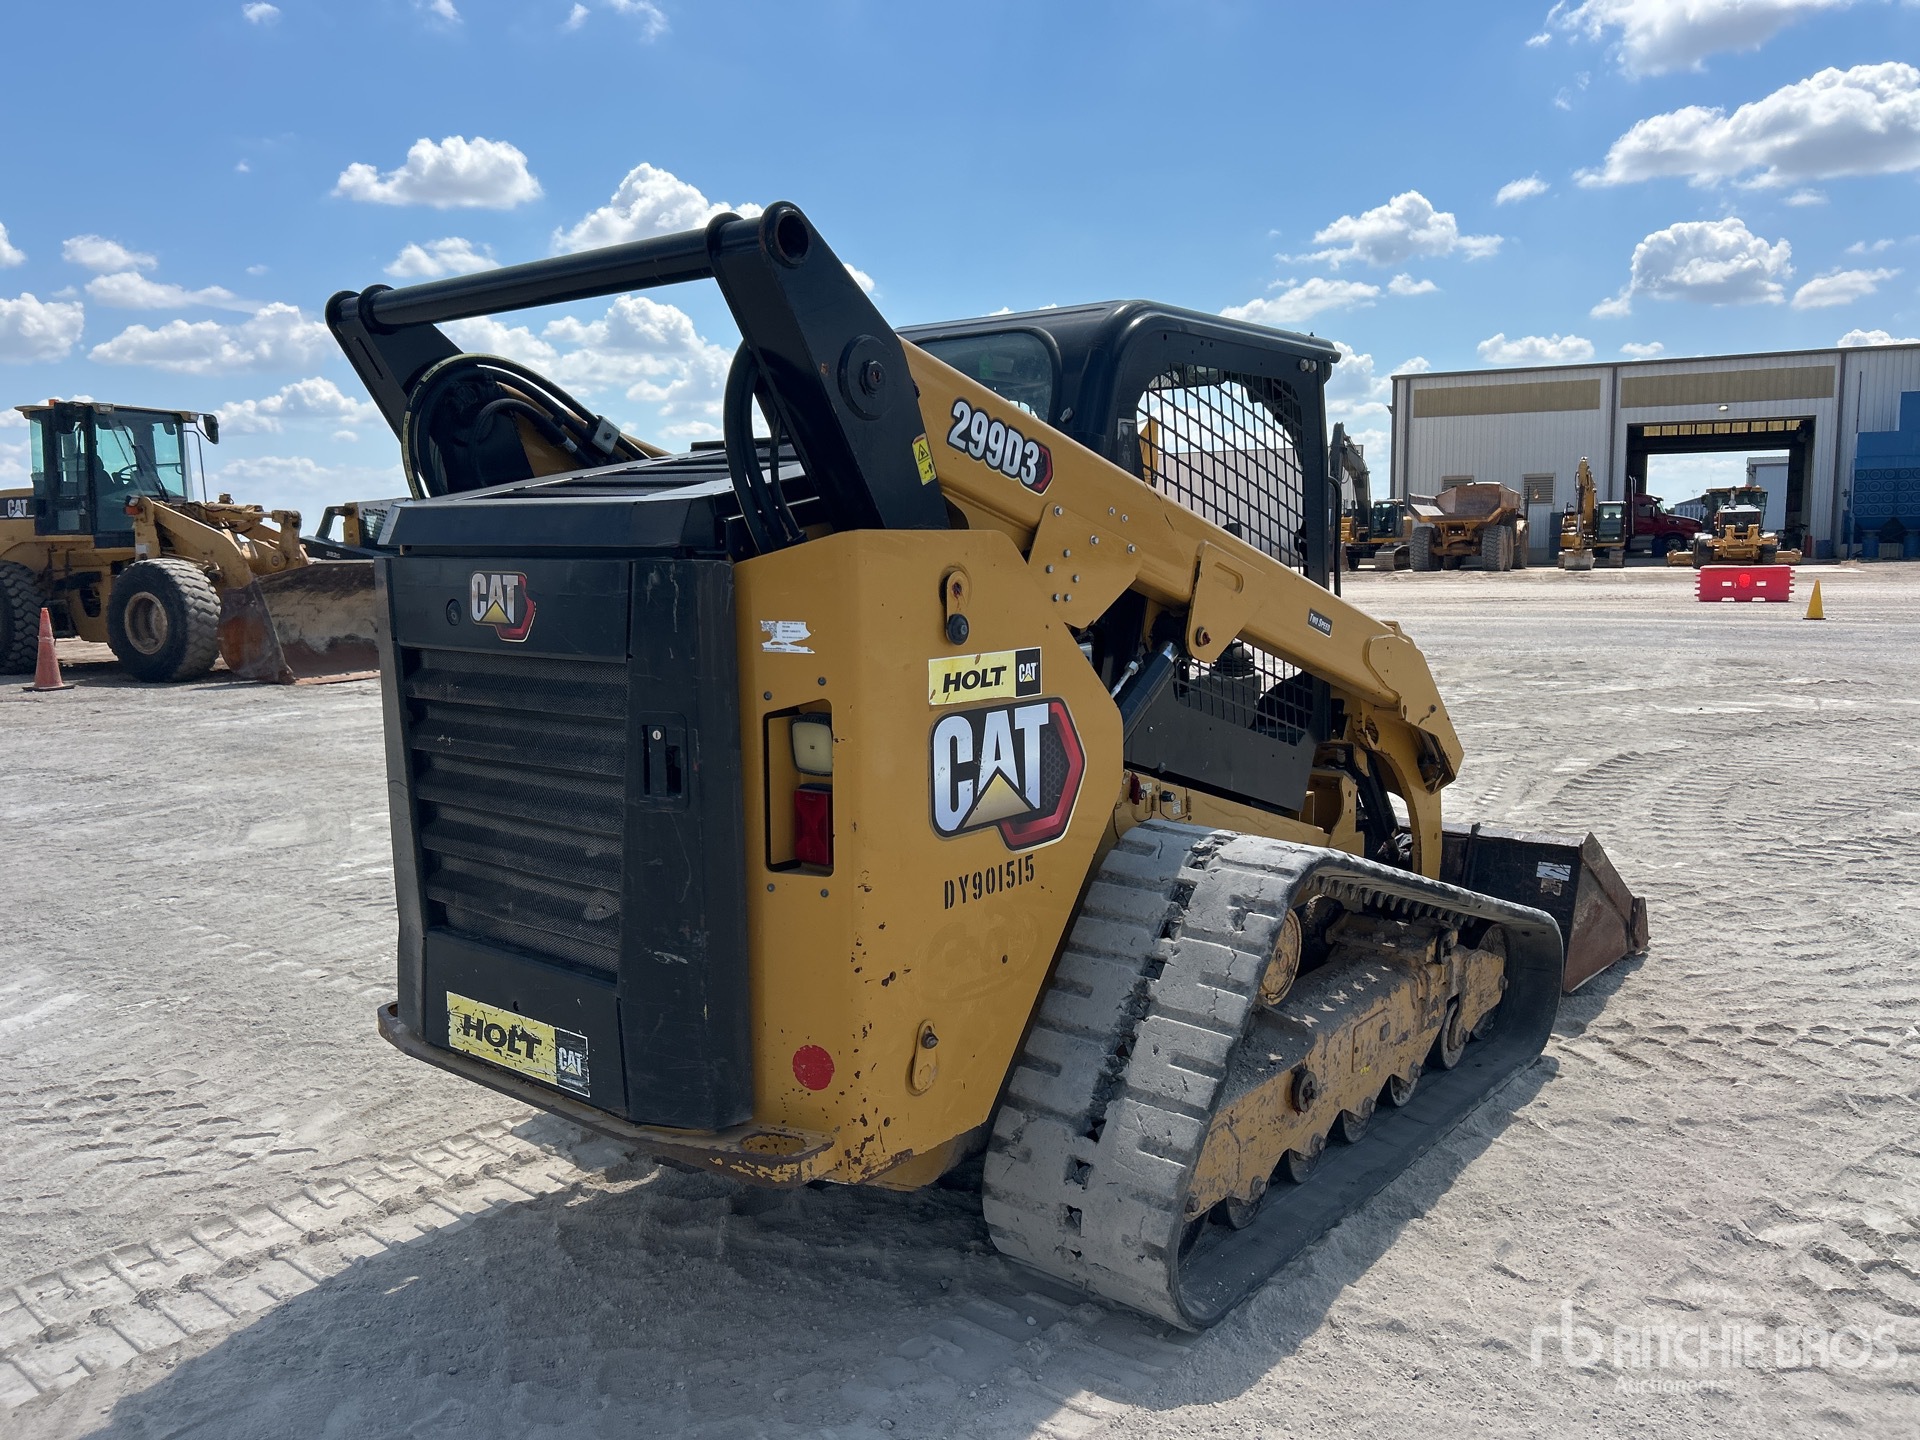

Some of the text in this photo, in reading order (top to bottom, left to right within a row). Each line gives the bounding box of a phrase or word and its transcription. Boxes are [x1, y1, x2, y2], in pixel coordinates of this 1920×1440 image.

[947, 400, 1040, 485] 299D3
[8, 499, 28, 517] CAT
[471, 573, 518, 624] CAT
[942, 662, 1037, 694] HOLT CAT
[933, 703, 1050, 832] CAT
[944, 854, 1035, 910] DY901515
[462, 1014, 583, 1077] HOLT CAT
